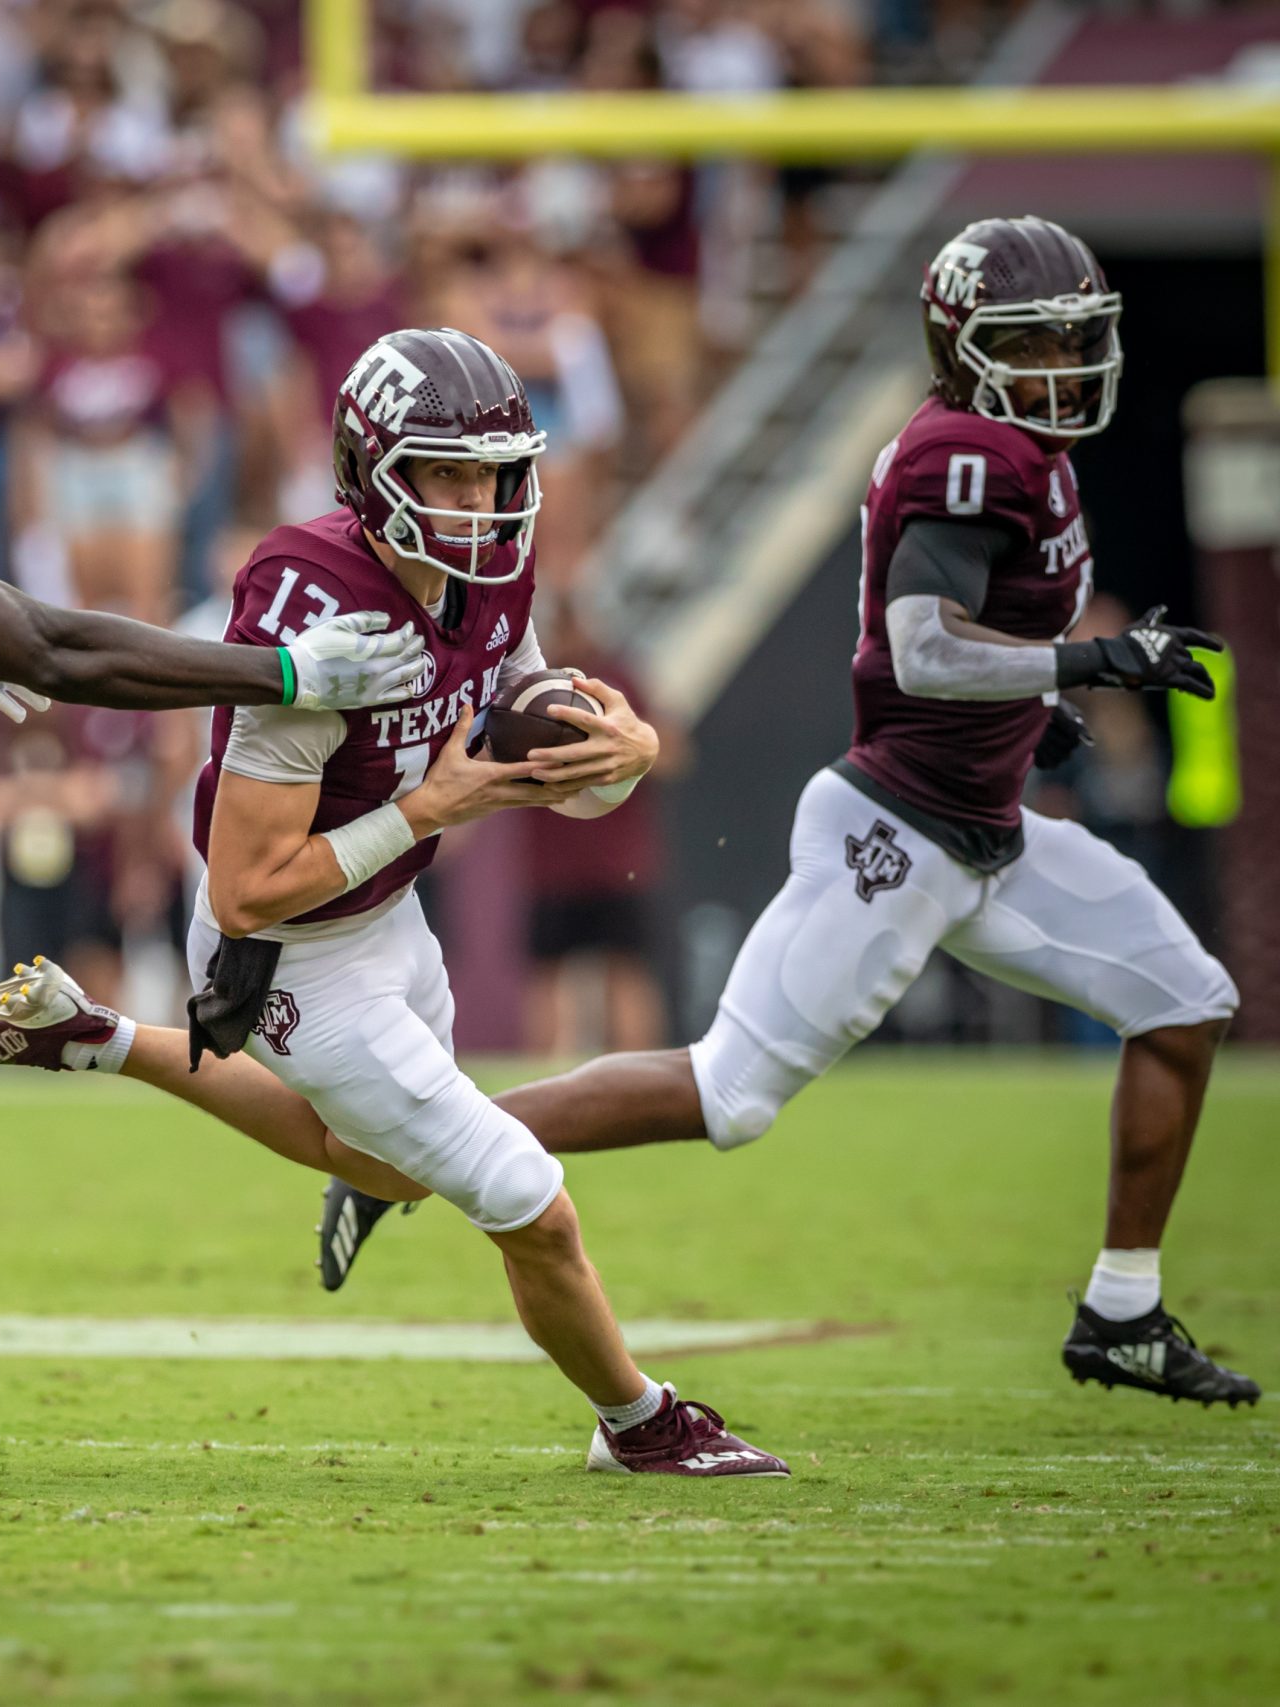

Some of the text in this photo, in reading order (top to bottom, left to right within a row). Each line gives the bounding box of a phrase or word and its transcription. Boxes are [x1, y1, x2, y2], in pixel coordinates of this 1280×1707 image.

[946, 454, 987, 515] 0
[257, 566, 340, 647] 13
[371, 679, 474, 748] TEXAS
